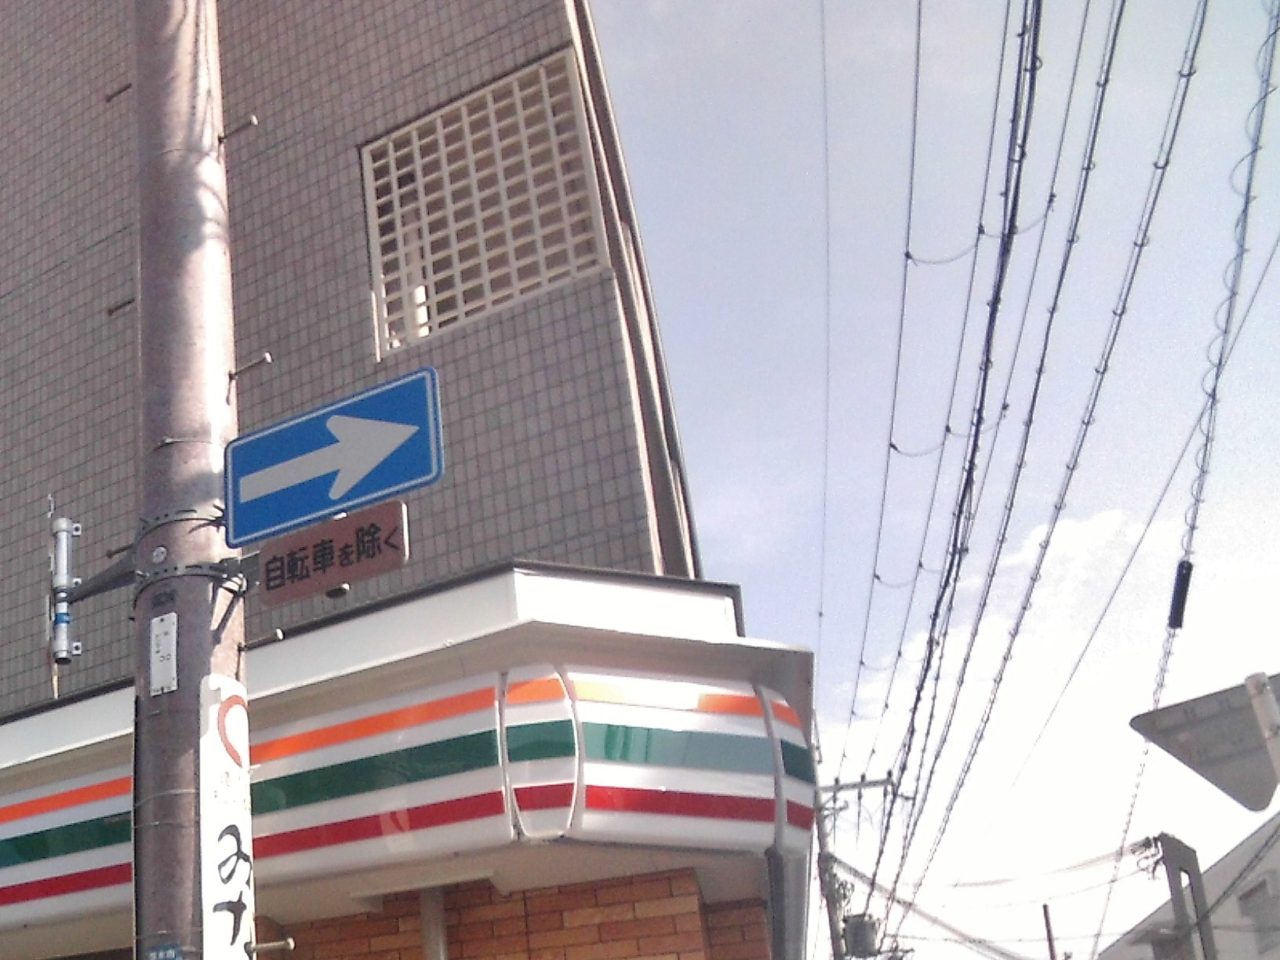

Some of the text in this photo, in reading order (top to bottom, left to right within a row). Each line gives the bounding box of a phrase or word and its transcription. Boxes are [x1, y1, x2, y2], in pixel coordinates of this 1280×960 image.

[265, 523, 399, 591] 自転車を除く
